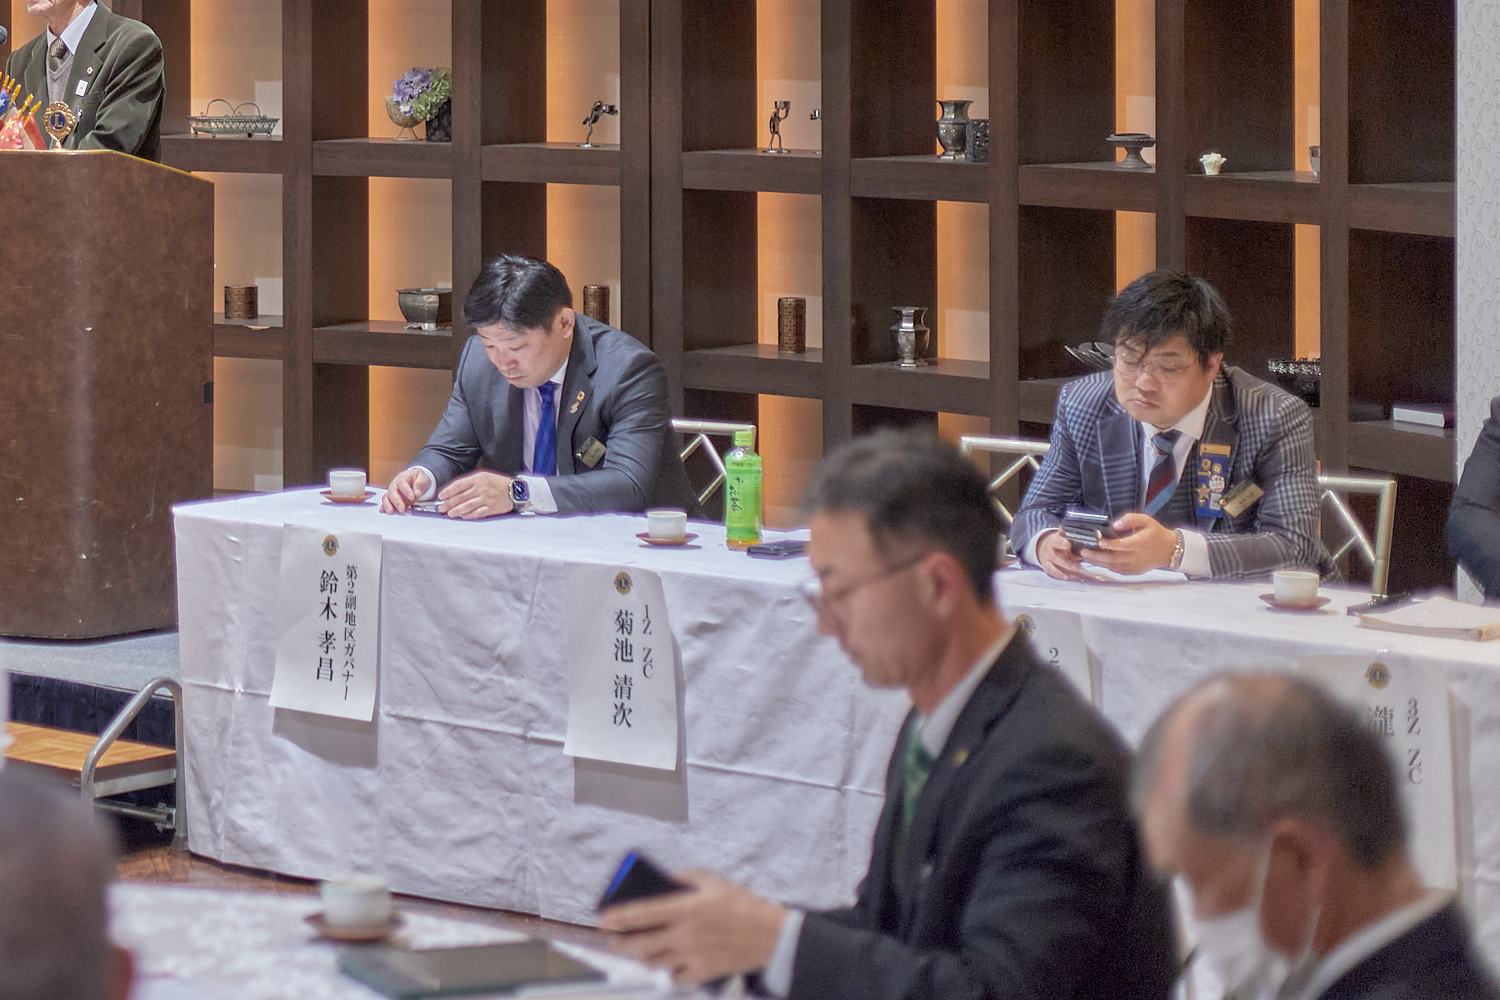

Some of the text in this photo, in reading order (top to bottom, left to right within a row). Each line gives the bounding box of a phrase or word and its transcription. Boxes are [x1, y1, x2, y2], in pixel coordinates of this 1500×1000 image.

[316, 569, 339, 682] 鈴木 孝昌
[342, 564, 358, 700] 第2副地区ガバナー
[612, 608, 634, 728] 菊池 清次
[642, 604, 654, 679] 1Z ZC
[1407, 698, 1422, 785] 3Z ZC
